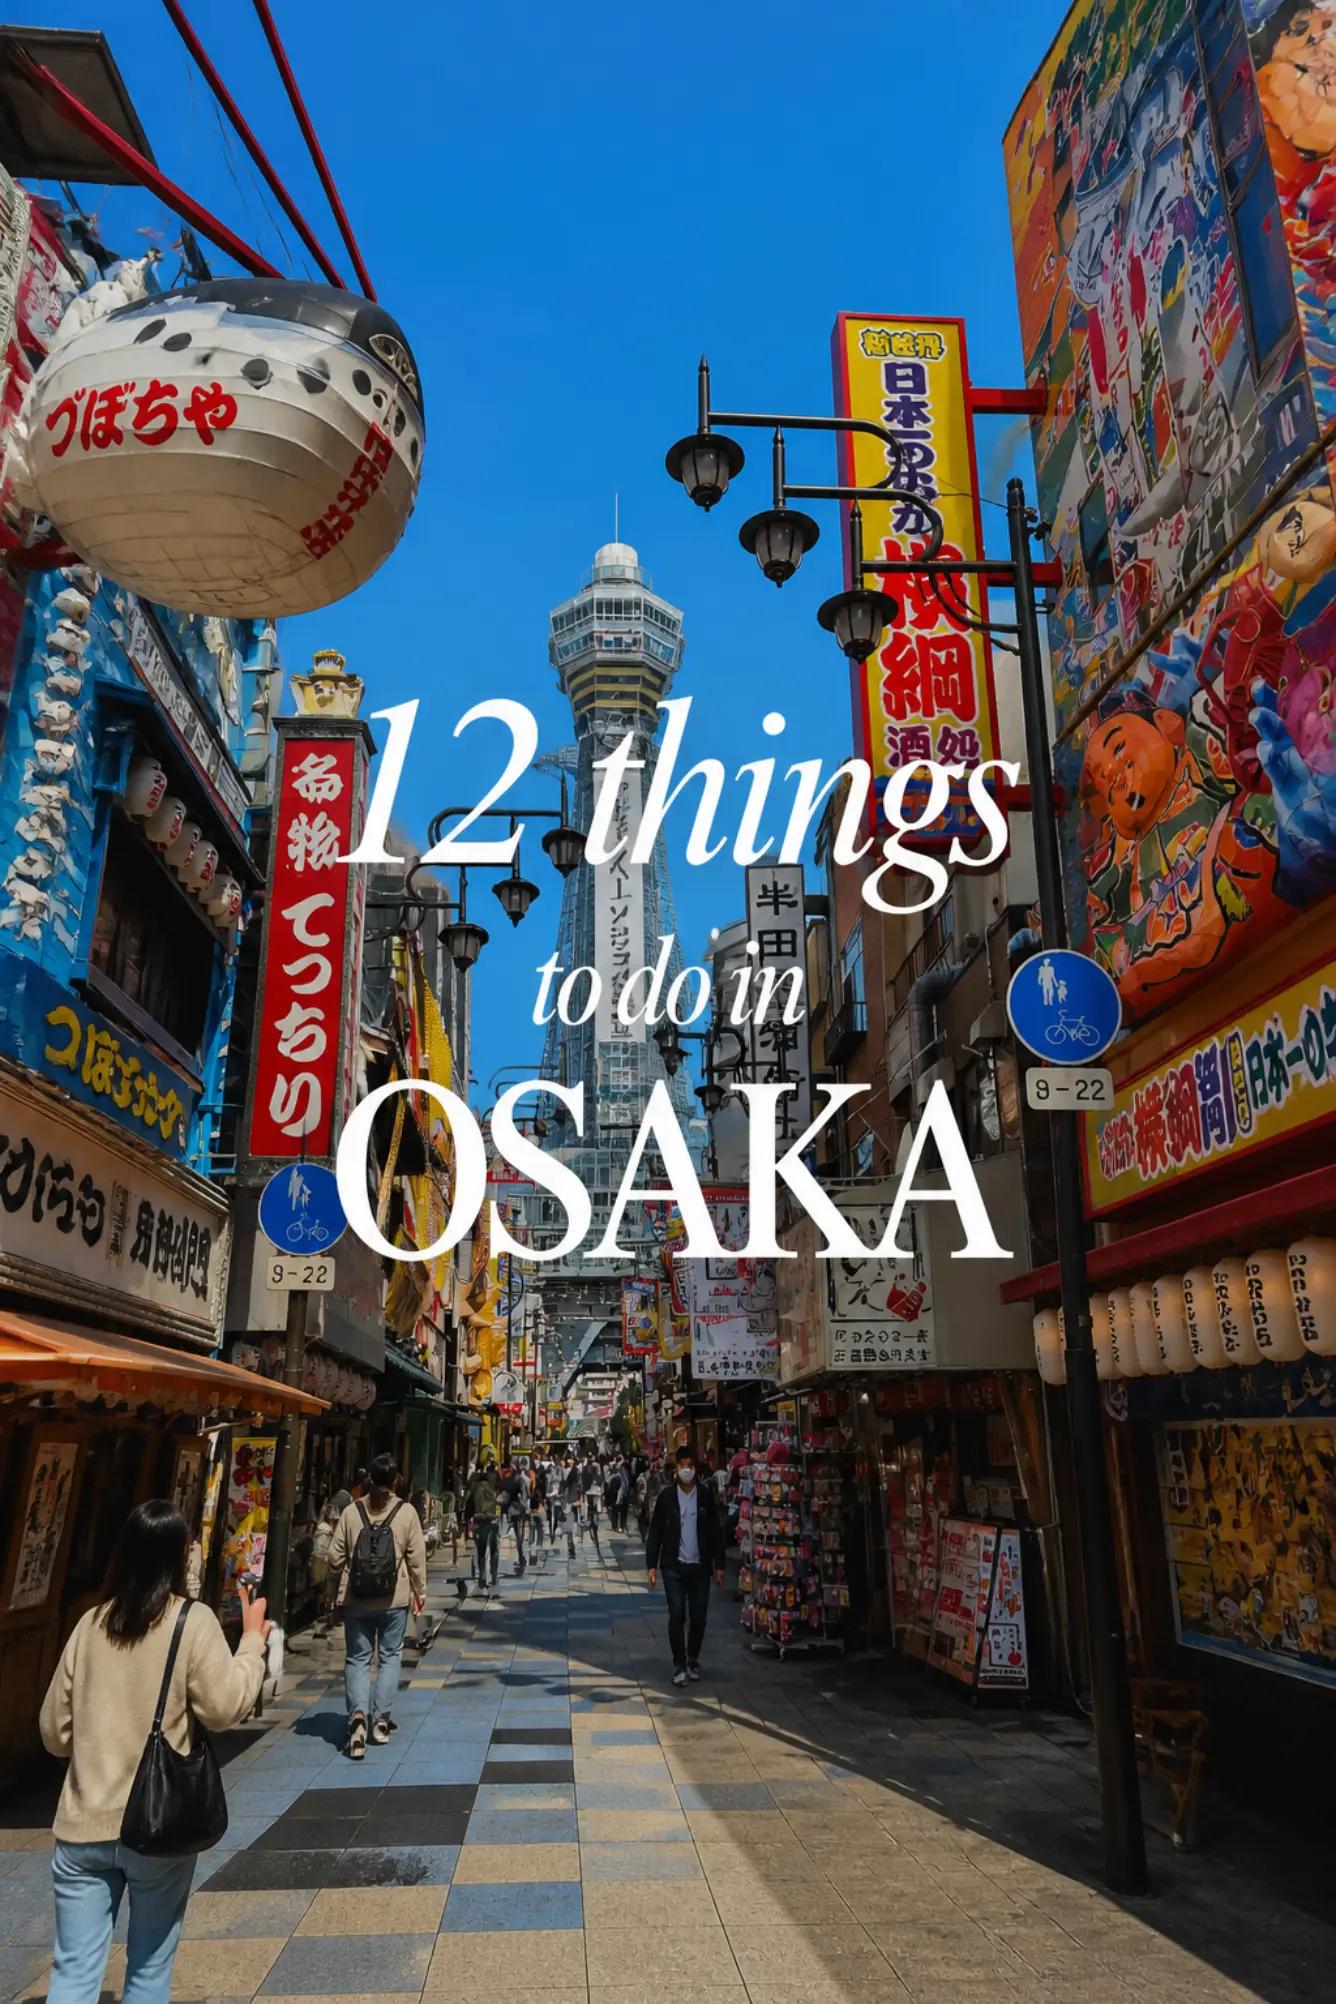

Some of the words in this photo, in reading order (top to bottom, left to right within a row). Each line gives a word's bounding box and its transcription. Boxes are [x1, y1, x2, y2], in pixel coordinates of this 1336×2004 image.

[287, 752, 343, 872] 名物
[1036, 1079, 1105, 1100] 9-22
[272, 1264, 327, 1284] 9-22
